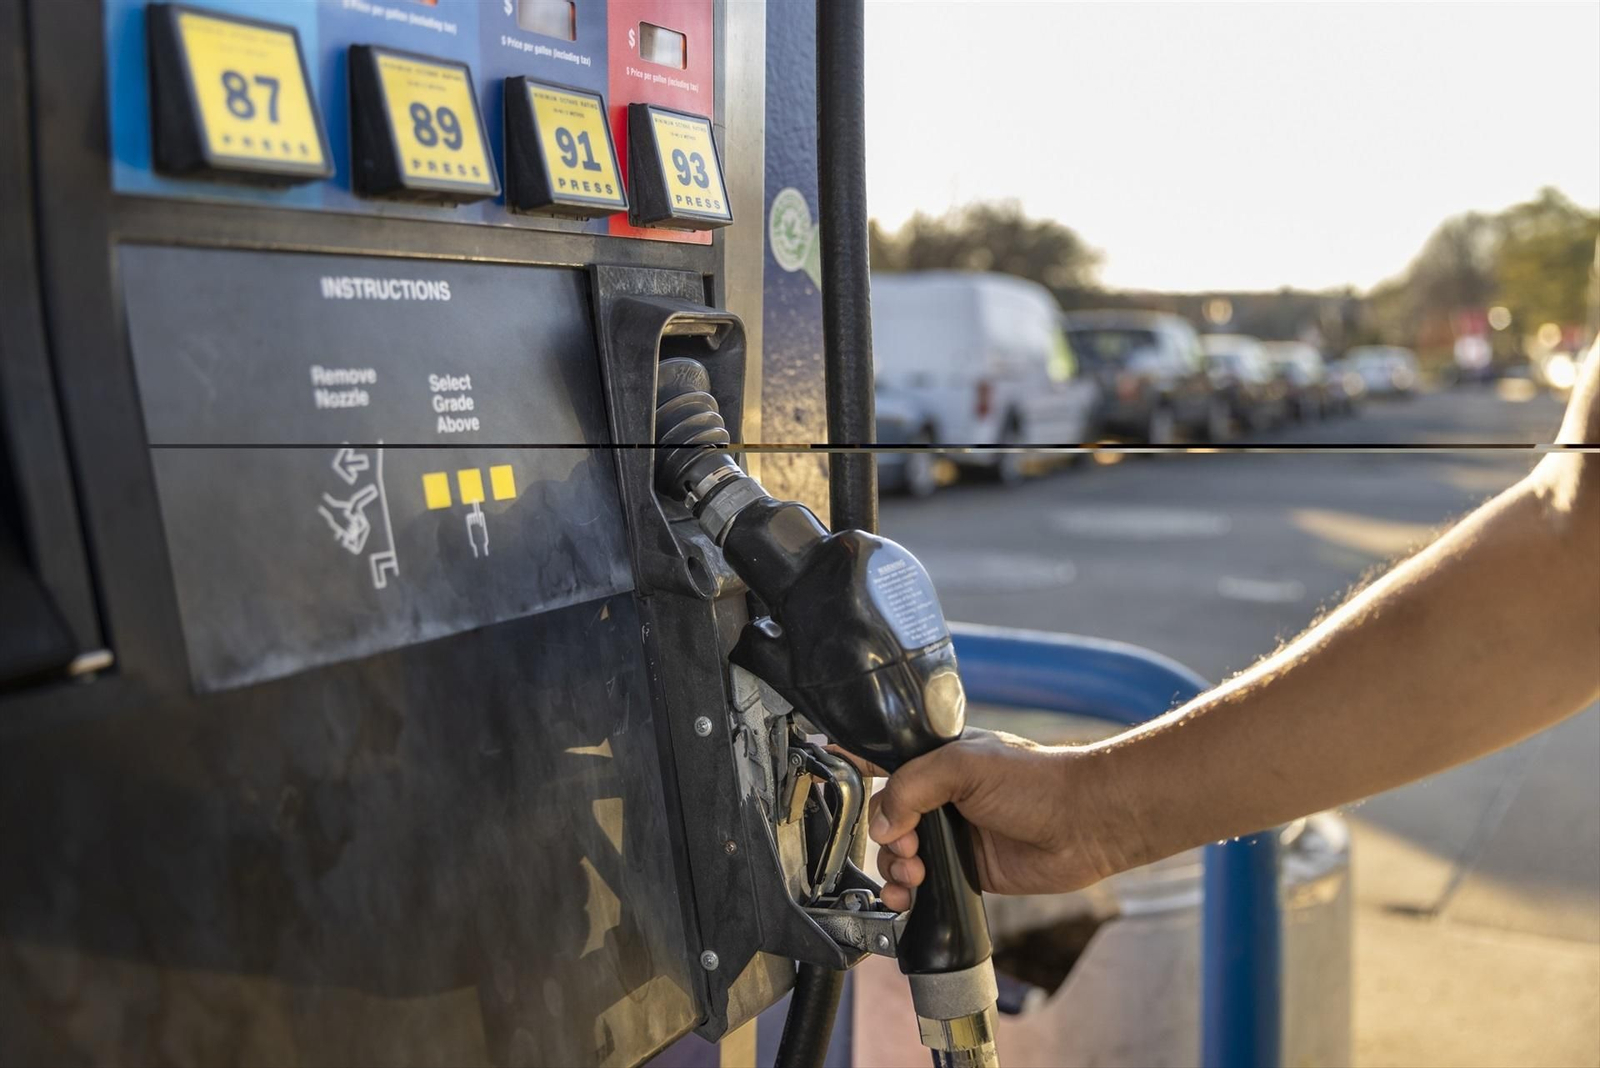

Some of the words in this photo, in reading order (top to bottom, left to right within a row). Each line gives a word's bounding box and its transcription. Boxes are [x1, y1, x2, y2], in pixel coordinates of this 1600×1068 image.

[504, 0, 513, 16] $
[628, 28, 636, 49] $
[501, 35, 506, 46] $
[507, 36, 523, 50] Price
[523, 42, 533, 52] per
[534, 44, 552, 57] gallon
[553, 48, 580, 65] (including
[580, 55, 591, 67] tax)
[626, 66, 630, 76] $
[630, 67, 643, 79] Price
[644, 72, 652, 81] per
[652, 73, 667, 85] gallon
[667, 77, 689, 91] (including
[689, 82, 699, 93] tax)
[221, 70, 280, 124] 87
[409, 102, 463, 151] 89
[555, 126, 602, 172] 91
[412, 159, 481, 178] PRESS
[672, 148, 710, 189] 93
[558, 177, 613, 195] PRESS
[675, 194, 721, 210] PRESS
[320, 276, 451, 301] INSTRUCTIONS
[310, 364, 377, 386] Remove
[428, 373, 472, 392] Select
[314, 387, 370, 409] Nozzle
[432, 394, 475, 413] Grade
[436, 415, 480, 434] Above
